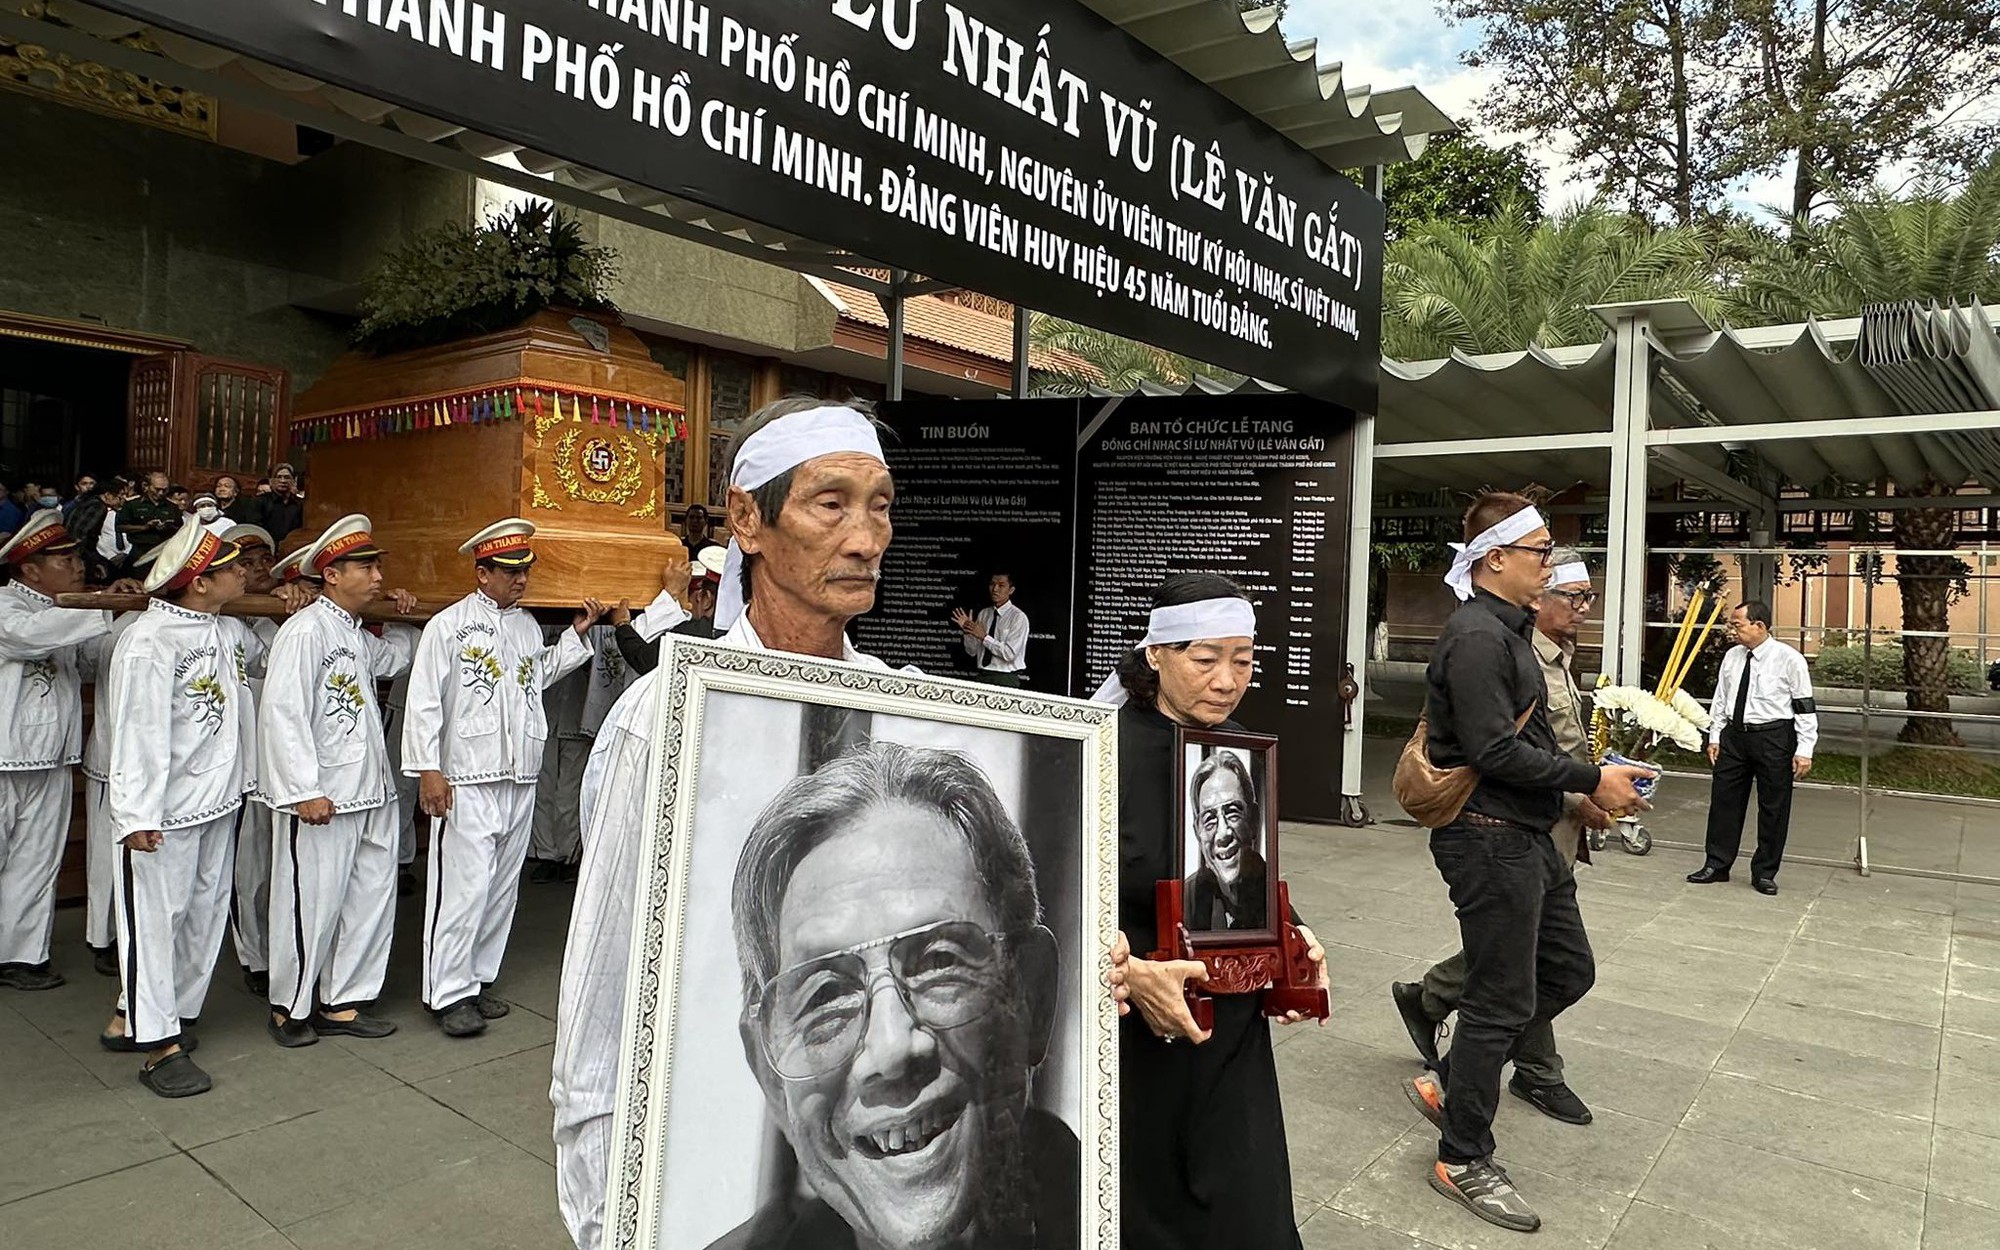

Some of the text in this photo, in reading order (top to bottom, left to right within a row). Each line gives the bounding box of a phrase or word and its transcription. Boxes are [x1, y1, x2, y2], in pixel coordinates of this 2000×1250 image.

[521, 23, 624, 110] PHỐ
[632, 68, 691, 137] HỒ
[700, 99, 768, 166] CHÍ
[772, 124, 873, 206] MINH.
[879, 164, 958, 236] ĐẢNG
[962, 198, 1019, 258] VIÊN
[1024, 223, 1071, 275] HUY
[1073, 244, 1120, 298] HIỆU
[1123, 265, 1147, 302] 45
[1150, 271, 1189, 319] NĂM
[1192, 288, 1228, 333] TUỔI
[1229, 300, 1273, 350] ĐẢNG.
[721, 15, 800, 92] PHỐ
[804, 55, 851, 116] HỒ
[857, 83, 910, 143] CHÍ
[913, 107, 994, 185] MINH,
[1000, 145, 1088, 220] NGUYÊN
[1092, 179, 1120, 231] ỦY
[1121, 200, 1163, 251] VIÊN
[1166, 221, 1202, 266] THƯ
[1202, 238, 1224, 276] KÝ
[1225, 249, 1251, 294] HỘI
[1253, 262, 1290, 310] NHẠC
[1290, 277, 1304, 312] SĨ
[1303, 287, 1330, 328] VIỆT
[1330, 299, 1360, 341] NAM,
[942, 3, 1089, 138] NHẤT
[1099, 90, 1158, 173] VŨ
[1169, 133, 1227, 211] (LÊ
[1235, 168, 1298, 248] VĂN
[1303, 200, 1362, 292] GẮT)
[919, 425, 944, 439] TIN
[1130, 421, 1161, 434] BAN
[1163, 416, 1183, 434] TỔ
[1186, 418, 1229, 434] CHỨC
[1251, 420, 1294, 434] TANG
[1133, 437, 1151, 451] CHÍ
[1152, 439, 1182, 454] NHẠC
[1194, 438, 1209, 450] LƯ
[1210, 436, 1238, 450] NHẤT
[1274, 436, 1297, 450] VĂN
[1299, 435, 1325, 451] GẮT)
